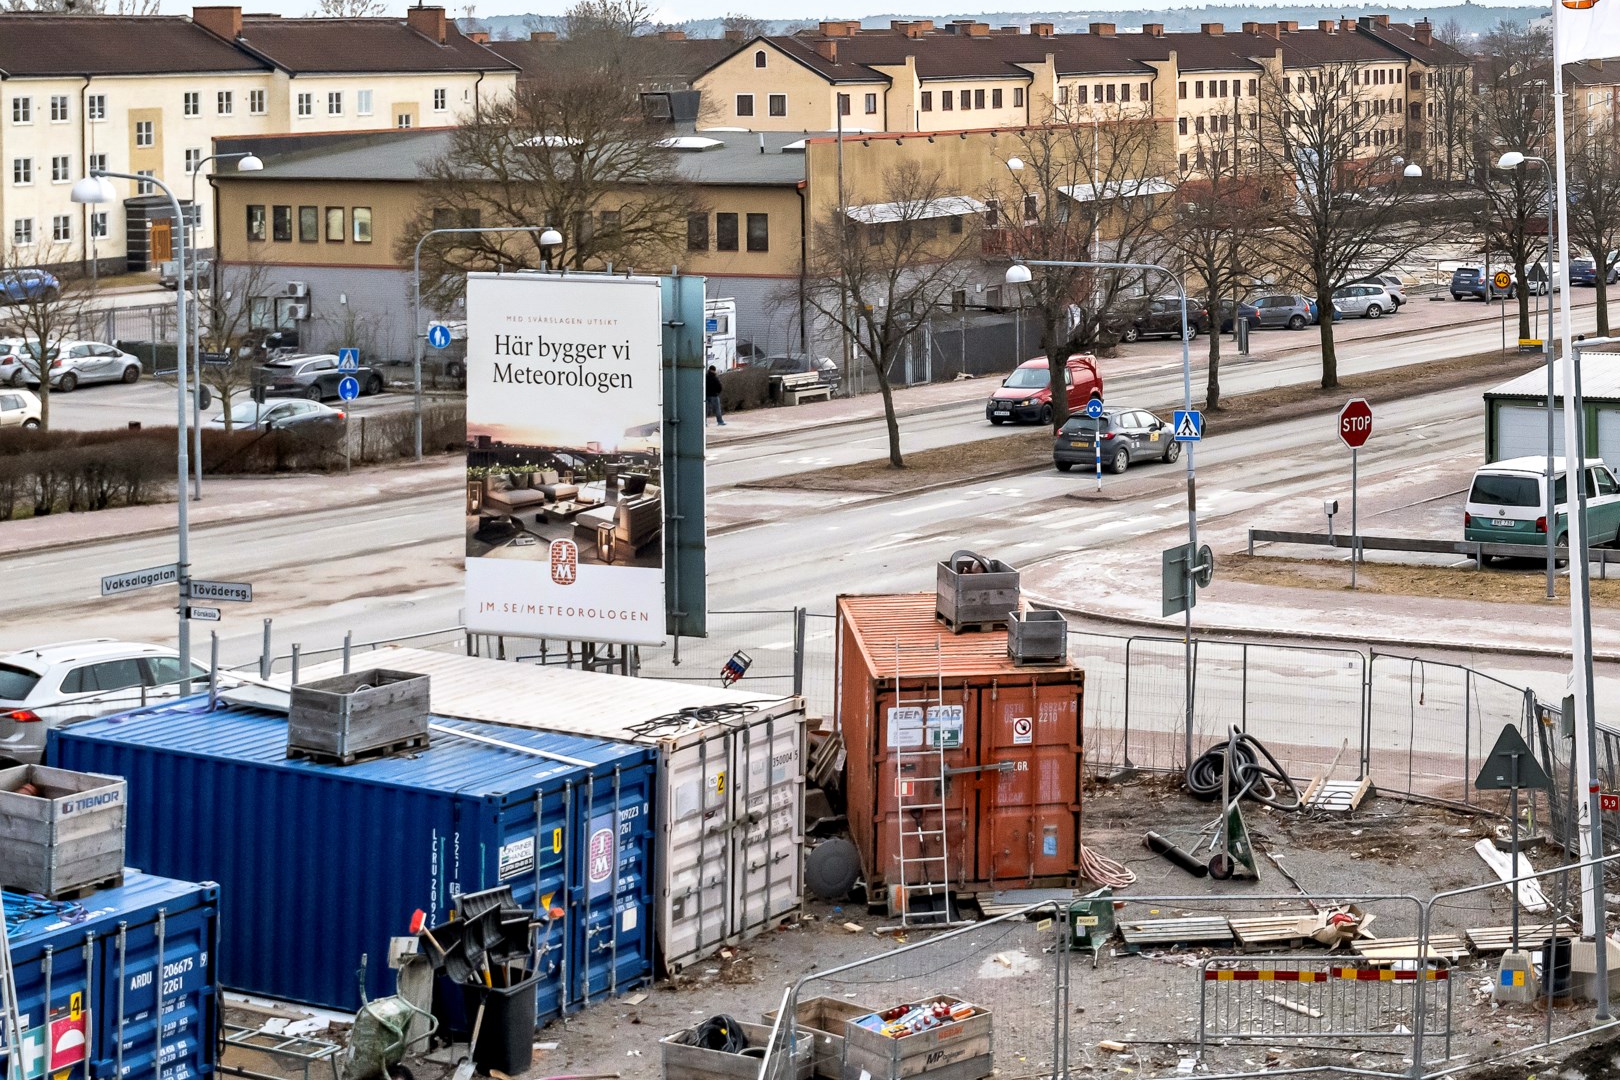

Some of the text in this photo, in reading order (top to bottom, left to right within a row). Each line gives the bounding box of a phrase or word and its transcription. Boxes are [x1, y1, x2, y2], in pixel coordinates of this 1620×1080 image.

[1496, 275, 1508, 285] 40
[506, 315, 524, 323] MED
[494, 334, 631, 364] Här bygger vi
[492, 362, 634, 393] Meteorologen
[1342, 415, 1371, 432] STOP
[555, 543, 574, 580] JM
[105, 569, 176, 592] Vaksalagatan
[193, 584, 250, 600] Tövädersg.
[479, 601, 649, 622] JM.SE/METEOROLOGEN
[1039, 712, 1058, 723] 2210
[794, 749, 799, 761] 5
[718, 775, 724, 791] 2
[76, 790, 119, 810] TIBNOR
[130, 971, 153, 991] ARDU
[163, 957, 194, 978] 206675
[163, 976, 183, 995] 22G1
[71, 996, 80, 1016] 4
